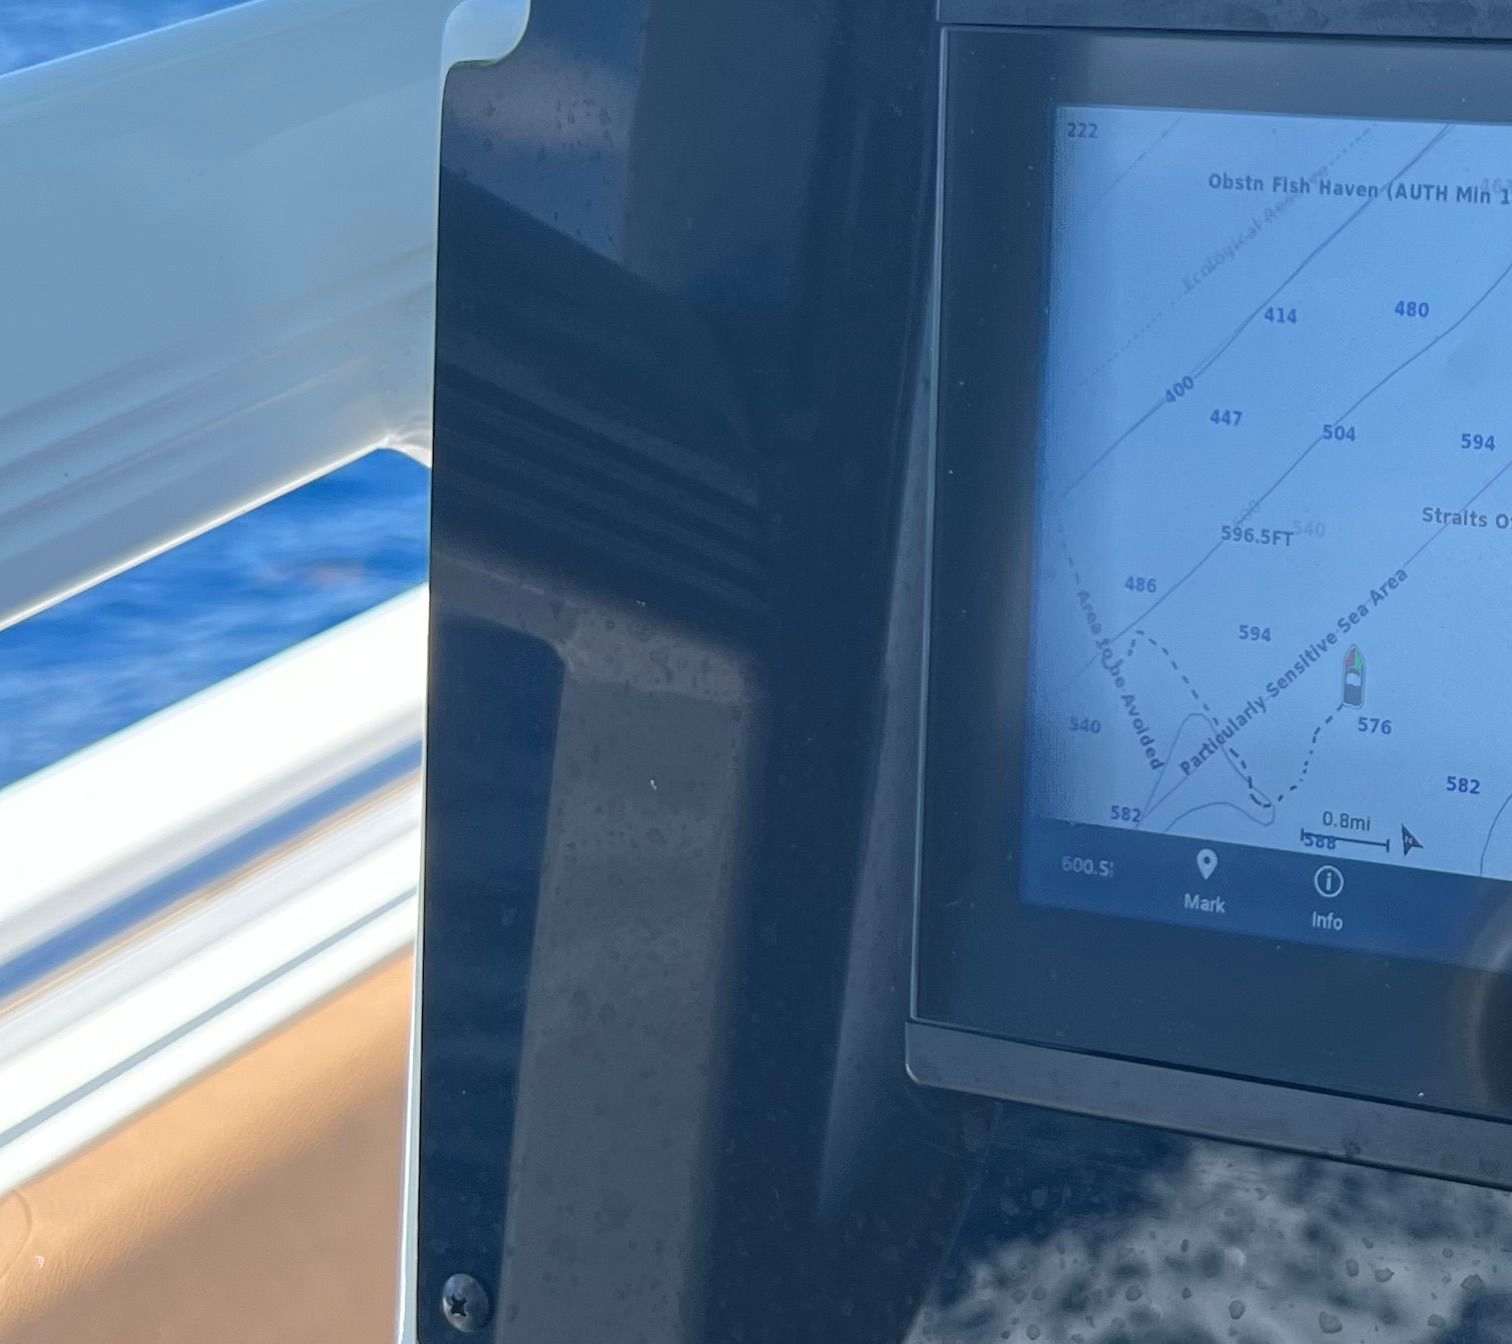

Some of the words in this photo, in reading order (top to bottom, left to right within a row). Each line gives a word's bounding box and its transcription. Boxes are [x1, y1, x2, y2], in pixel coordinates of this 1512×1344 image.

[1067, 122, 1098, 138] 222
[1208, 173, 1264, 192] Obstn
[1272, 176, 1310, 195] Fish
[1319, 178, 1378, 198] Haven
[1386, 182, 1448, 203] (AUTH
[1456, 186, 1491, 205] Min
[1264, 307, 1297, 324] 414
[1394, 300, 1429, 318] 480
[1164, 375, 1195, 404] 400
[1209, 408, 1243, 427] 447
[1322, 424, 1356, 441] 504
[1460, 433, 1496, 451] 594
[1422, 506, 1488, 528] Straits
[1220, 525, 1295, 547] 596.5FT
[1124, 575, 1158, 594] 486
[1238, 624, 1272, 642] 594
[1179, 693, 1268, 776] Particularly
[1265, 631, 1338, 699] Sensitive
[1337, 603, 1370, 633] Sea
[1368, 567, 1409, 606] Area
[1121, 692, 1166, 771] Avoided
[1358, 716, 1392, 735] 576
[1446, 775, 1481, 795] 582
[1110, 805, 1142, 824] 582
[1322, 810, 1371, 832] 0.8mi
[1184, 893, 1225, 914] Mark
[1312, 911, 1344, 931] Info
